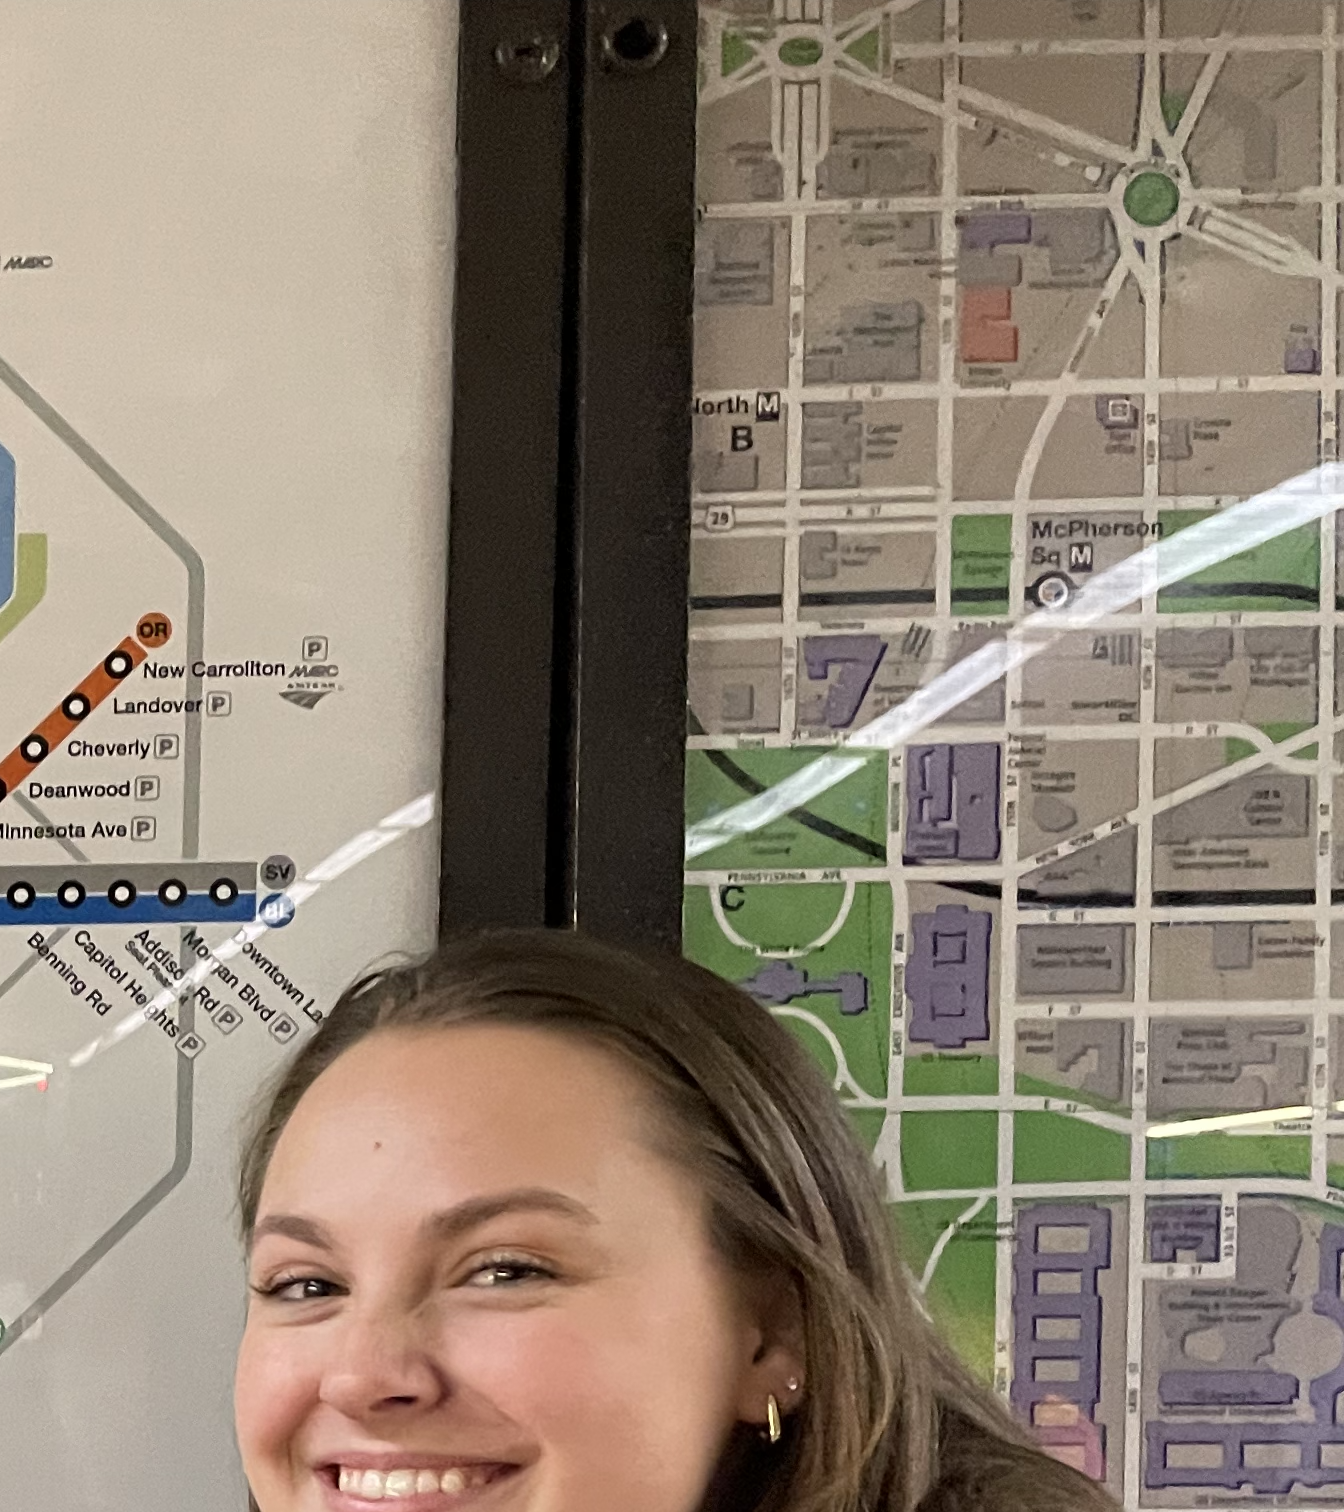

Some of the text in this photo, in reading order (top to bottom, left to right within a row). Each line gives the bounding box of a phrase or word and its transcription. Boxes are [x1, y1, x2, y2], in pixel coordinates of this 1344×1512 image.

[732, 426, 753, 451] B
[1031, 520, 1163, 540] McPherson
[1031, 547, 1060, 566] Sq
[143, 661, 286, 680] New Carrollton
[113, 698, 203, 714] Landover
[67, 740, 151, 761] Cheverly
[29, 781, 131, 799] Deanwood
[91, 821, 127, 838] Ave
[264, 864, 292, 881] SV
[720, 885, 745, 911] C
[27, 931, 87, 996] Benning
[85, 988, 113, 1018] Rd
